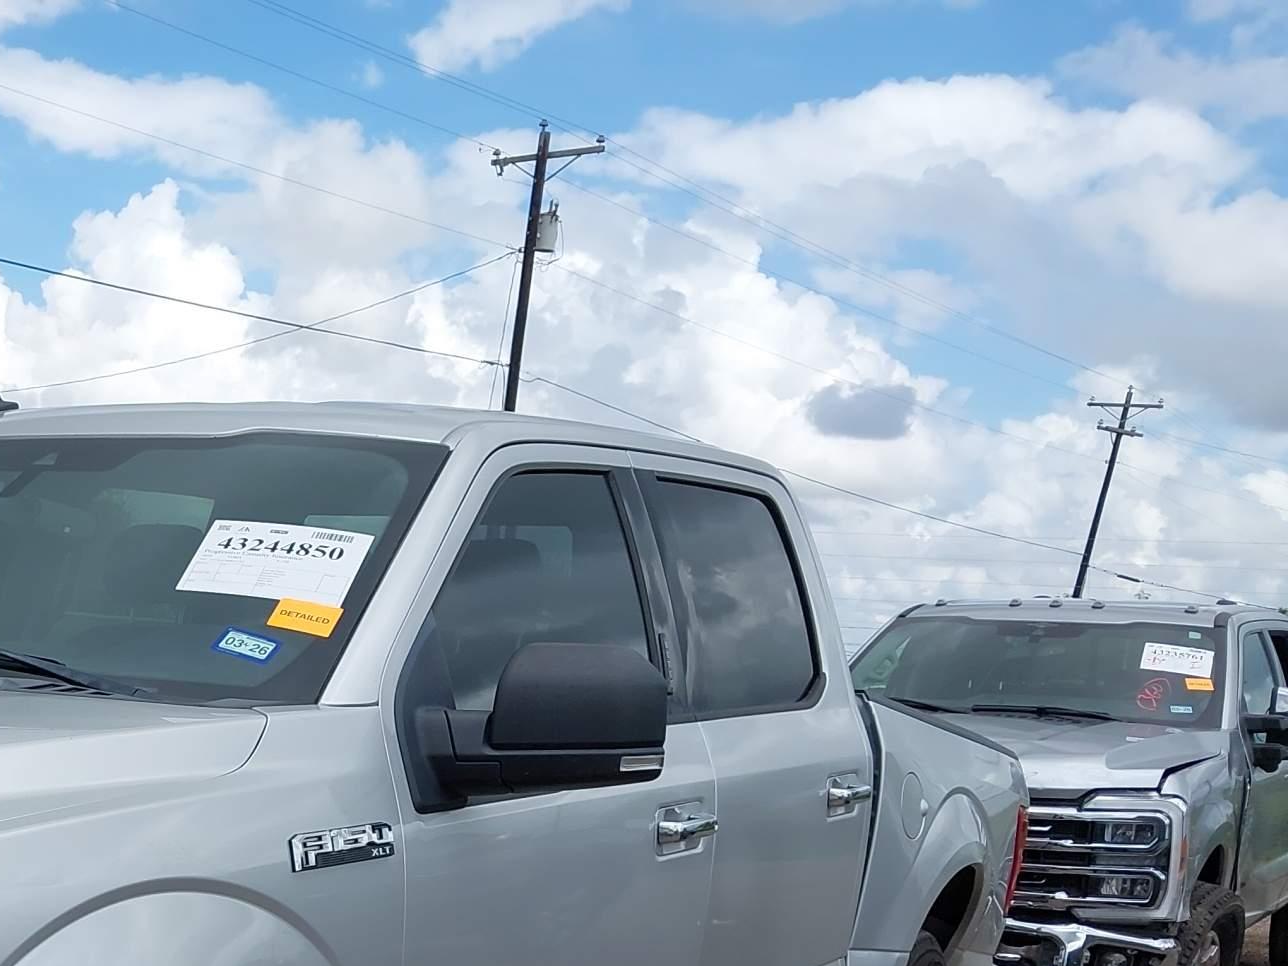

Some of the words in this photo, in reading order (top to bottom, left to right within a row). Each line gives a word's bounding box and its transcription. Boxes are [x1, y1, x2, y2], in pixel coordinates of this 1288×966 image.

[218, 536, 344, 561] 43244850
[279, 609, 330, 625] DETAILED
[371, 846, 391, 857] XLT
